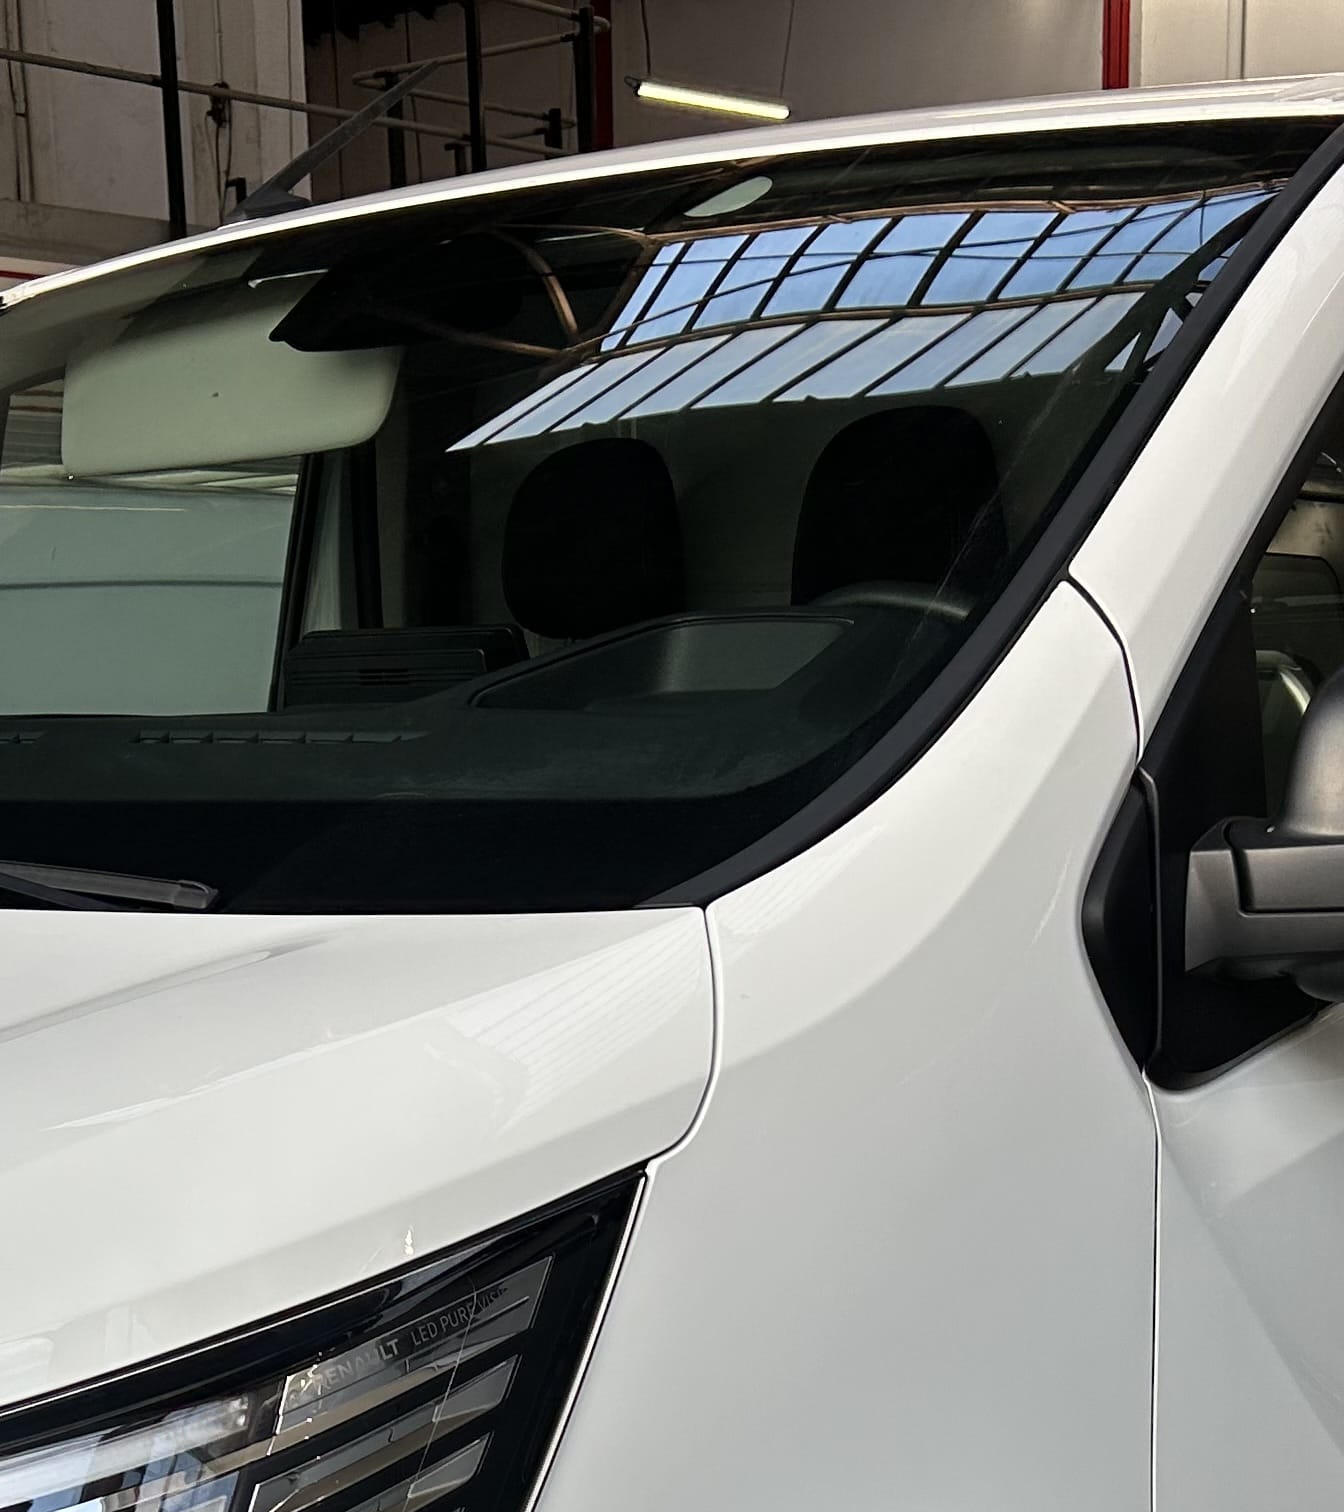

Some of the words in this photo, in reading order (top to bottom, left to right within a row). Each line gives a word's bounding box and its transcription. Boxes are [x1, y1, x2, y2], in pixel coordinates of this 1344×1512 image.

[312, 1338, 399, 1390] RENAULT
[411, 1322, 438, 1346] LED
[440, 1302, 479, 1333] PURE
[477, 1287, 510, 1312] VISI
